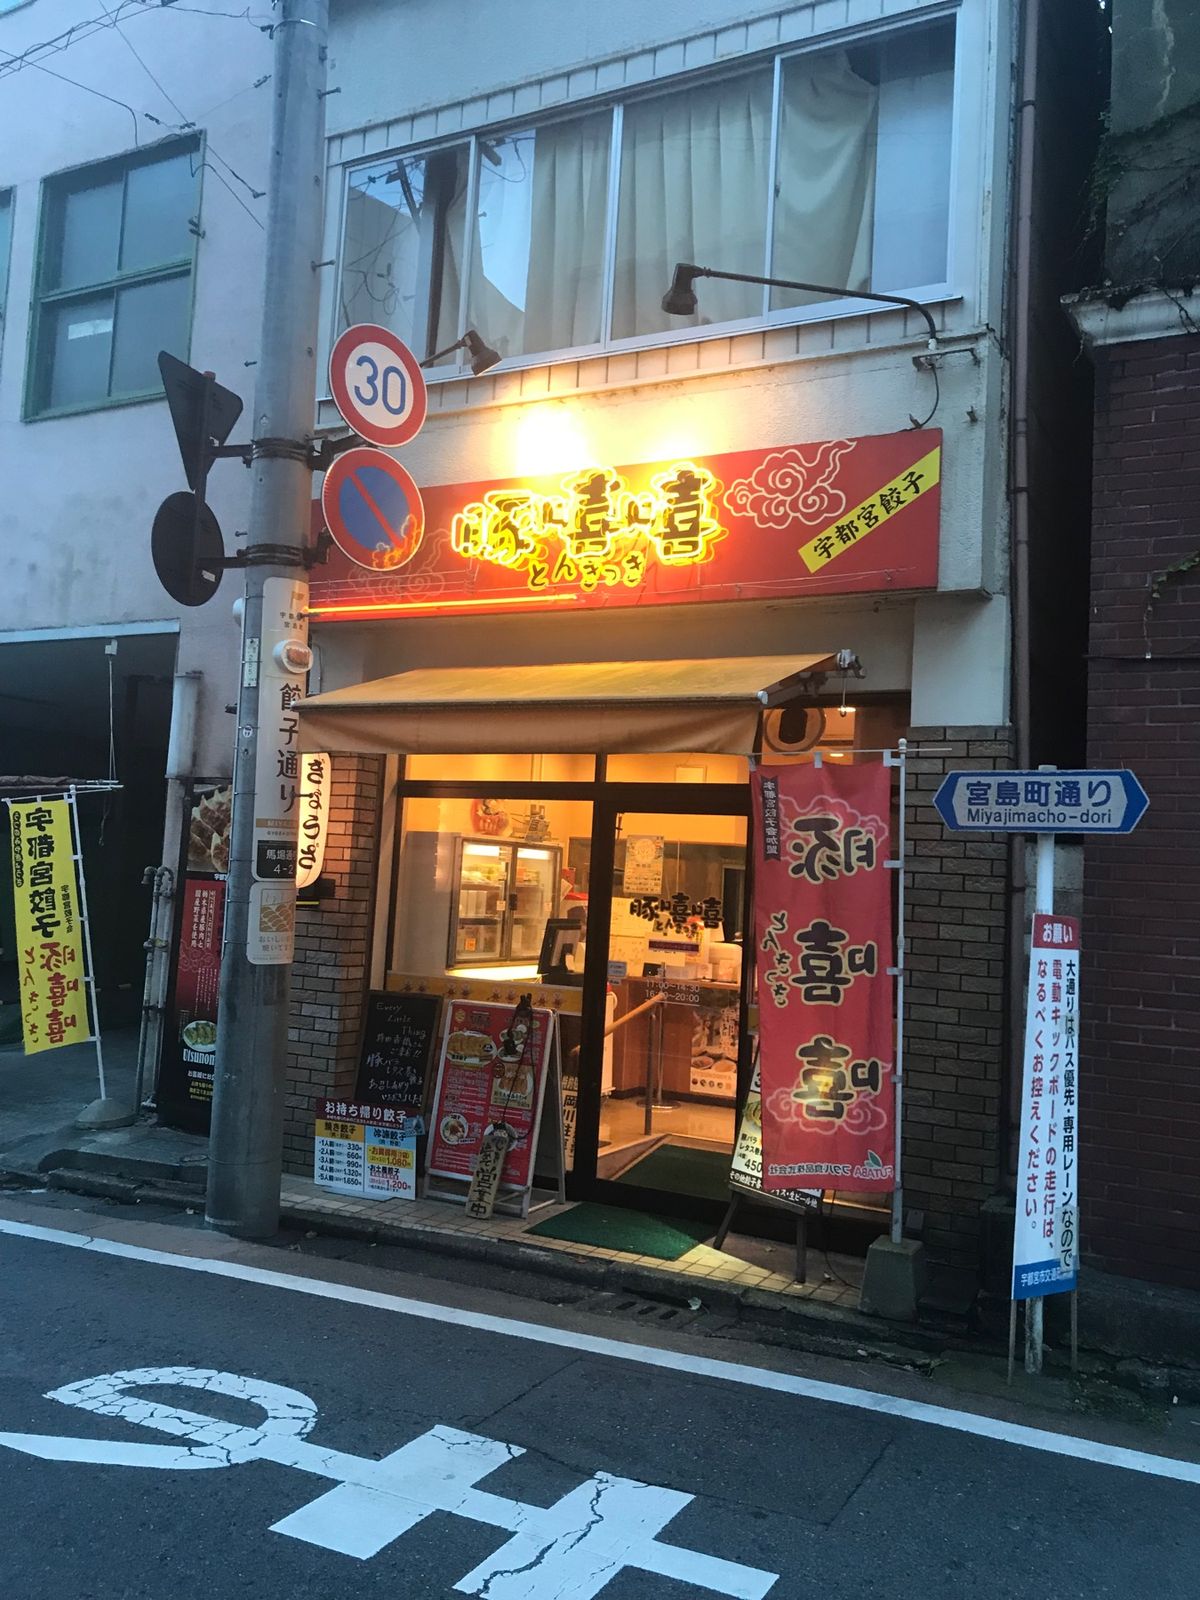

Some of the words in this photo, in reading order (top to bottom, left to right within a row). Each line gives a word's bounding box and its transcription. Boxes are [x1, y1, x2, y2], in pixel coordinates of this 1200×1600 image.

[354, 356, 407, 415] 30
[814, 471, 925, 559] 宇都宮餃子
[529, 551, 644, 591] とんきっき
[276, 683, 302, 813] 餃子通り
[966, 780, 1112, 808] 宮島町通り
[966, 808, 1112, 826] Miyajimacho-dori
[1043, 923, 1073, 944] お願い
[645, 989, 700, 1003] 16:0～20:00
[325, 1101, 407, 1123] お持ち帰り餃子
[1025, 959, 1048, 1229] なるべくお控えください。
[1042, 959, 1062, 1249] 電動キックボードの走行は、
[1060, 959, 1076, 1268] 大通りはバス優先・専用レーンなので
